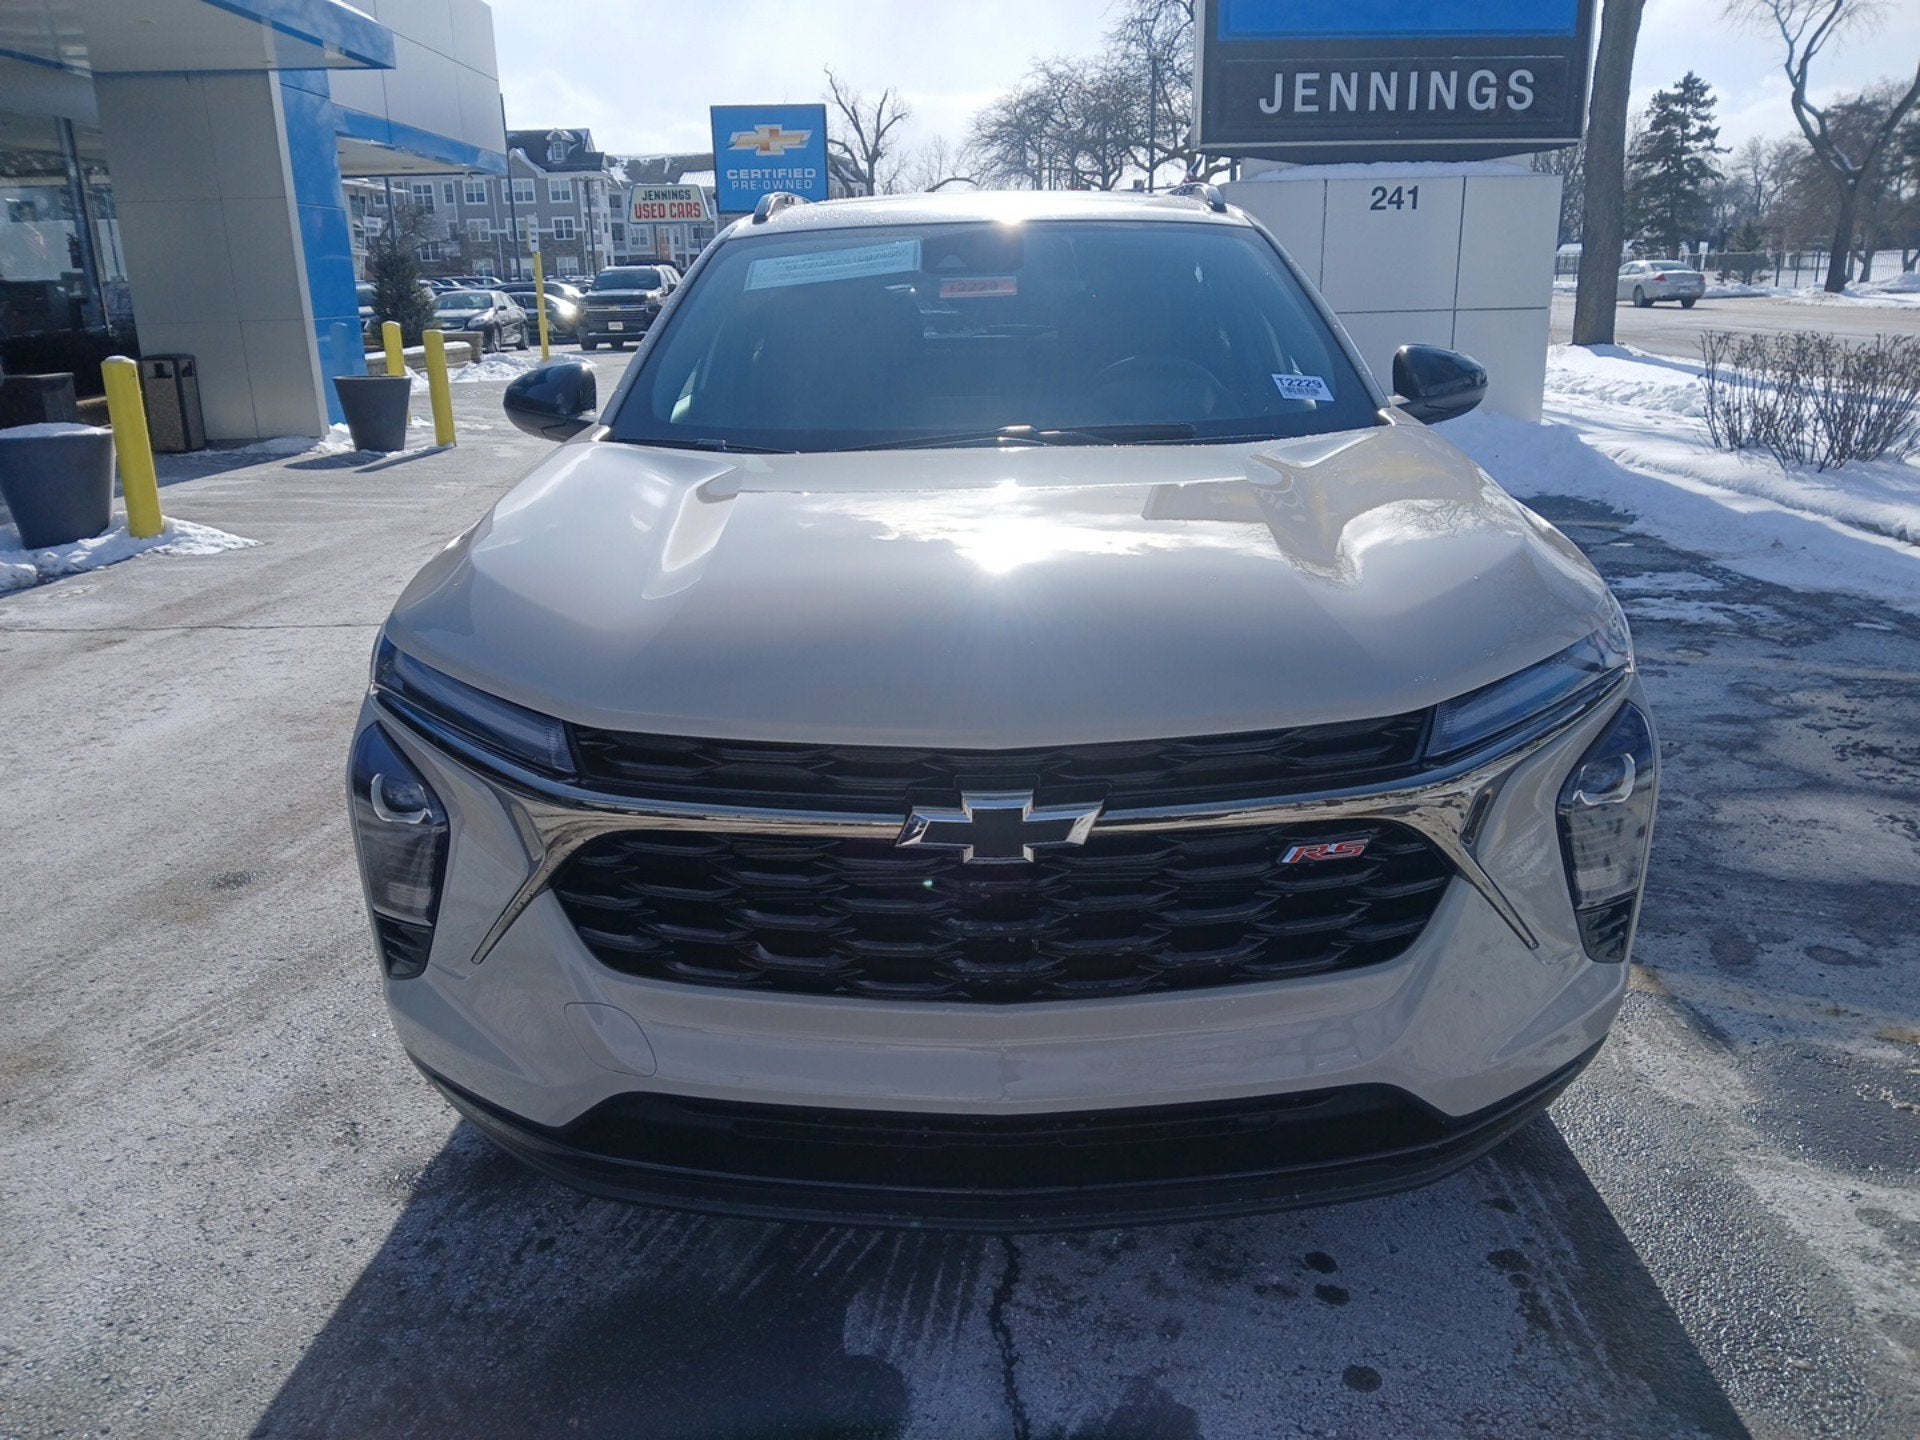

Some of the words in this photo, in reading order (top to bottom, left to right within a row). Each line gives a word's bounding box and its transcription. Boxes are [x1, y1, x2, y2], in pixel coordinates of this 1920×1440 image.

[1259, 69, 1534, 114] JENNINGS
[726, 168, 816, 180] CERTIFIED
[731, 180, 813, 190] PRE-OWNED
[642, 190, 691, 201] JENNINGS
[1370, 185, 1419, 211] 241
[634, 203, 665, 220] USED
[669, 202, 701, 219] CARS
[1276, 378, 1322, 389] T2229
[1281, 838, 1369, 864] RS
